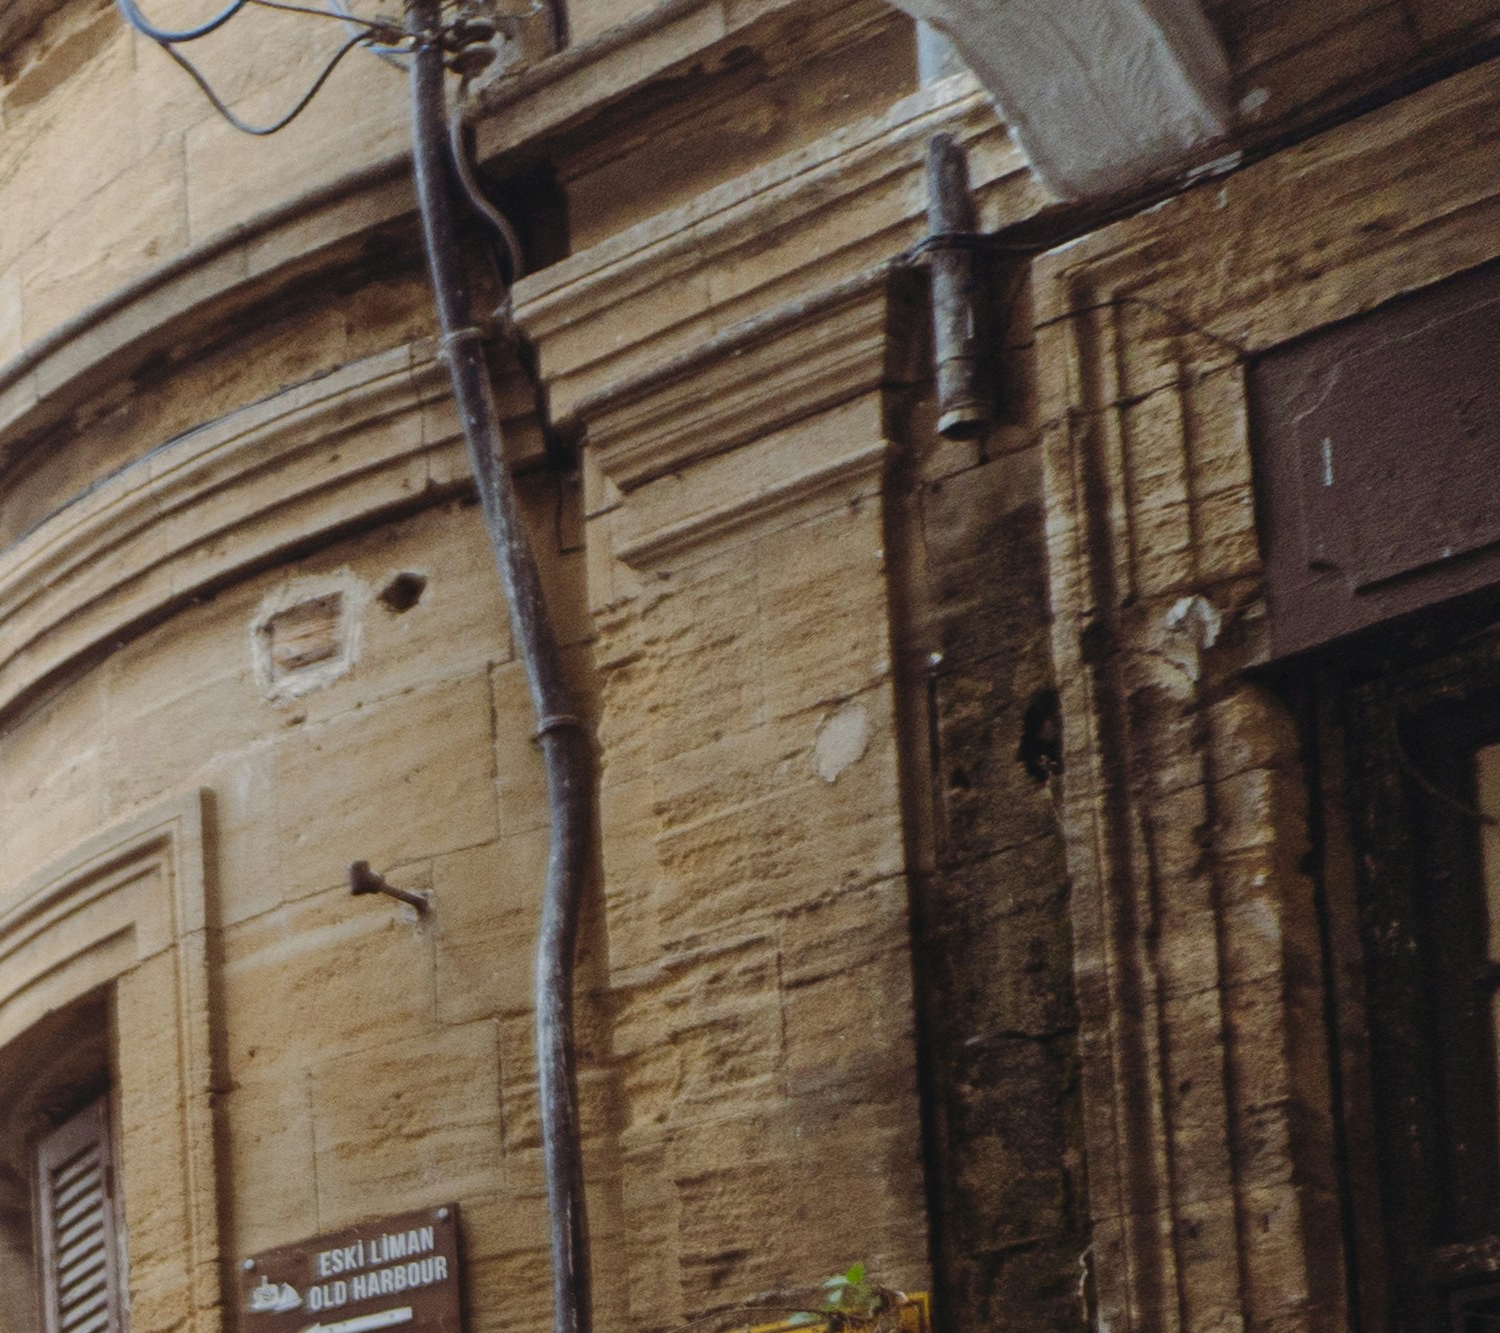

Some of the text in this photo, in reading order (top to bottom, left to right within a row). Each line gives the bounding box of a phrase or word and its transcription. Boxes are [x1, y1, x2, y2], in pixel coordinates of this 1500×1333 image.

[319, 1226, 435, 1278] ESKİ LİMAN
[309, 1256, 448, 1311] OLD HARBOUR
